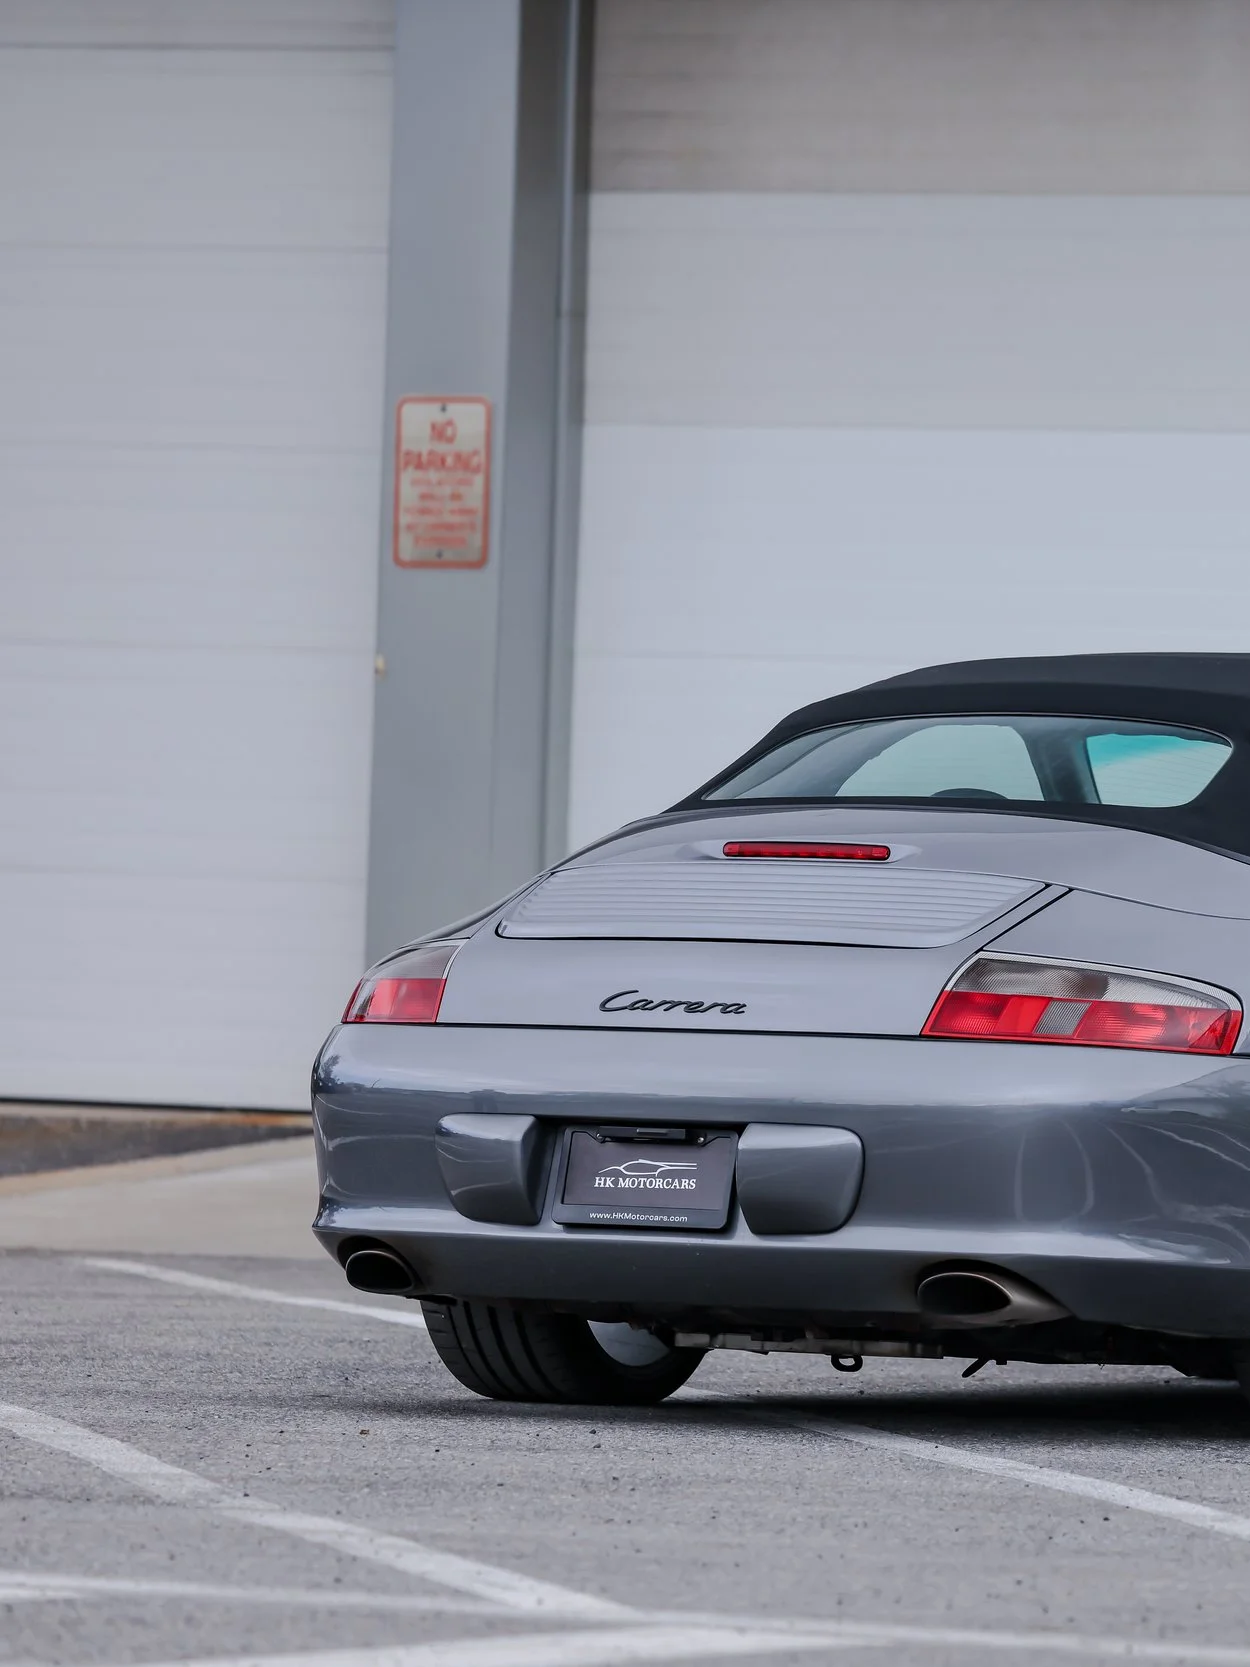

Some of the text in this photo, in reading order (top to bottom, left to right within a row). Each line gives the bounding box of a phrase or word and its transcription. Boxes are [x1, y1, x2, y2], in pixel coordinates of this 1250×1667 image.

[429, 417, 458, 444] NO
[403, 448, 483, 475] PARKING
[599, 989, 748, 1014] Carrera
[594, 1176, 697, 1190] HK MOTORCARS
[589, 1211, 688, 1223] www.HKMotorcars.com
